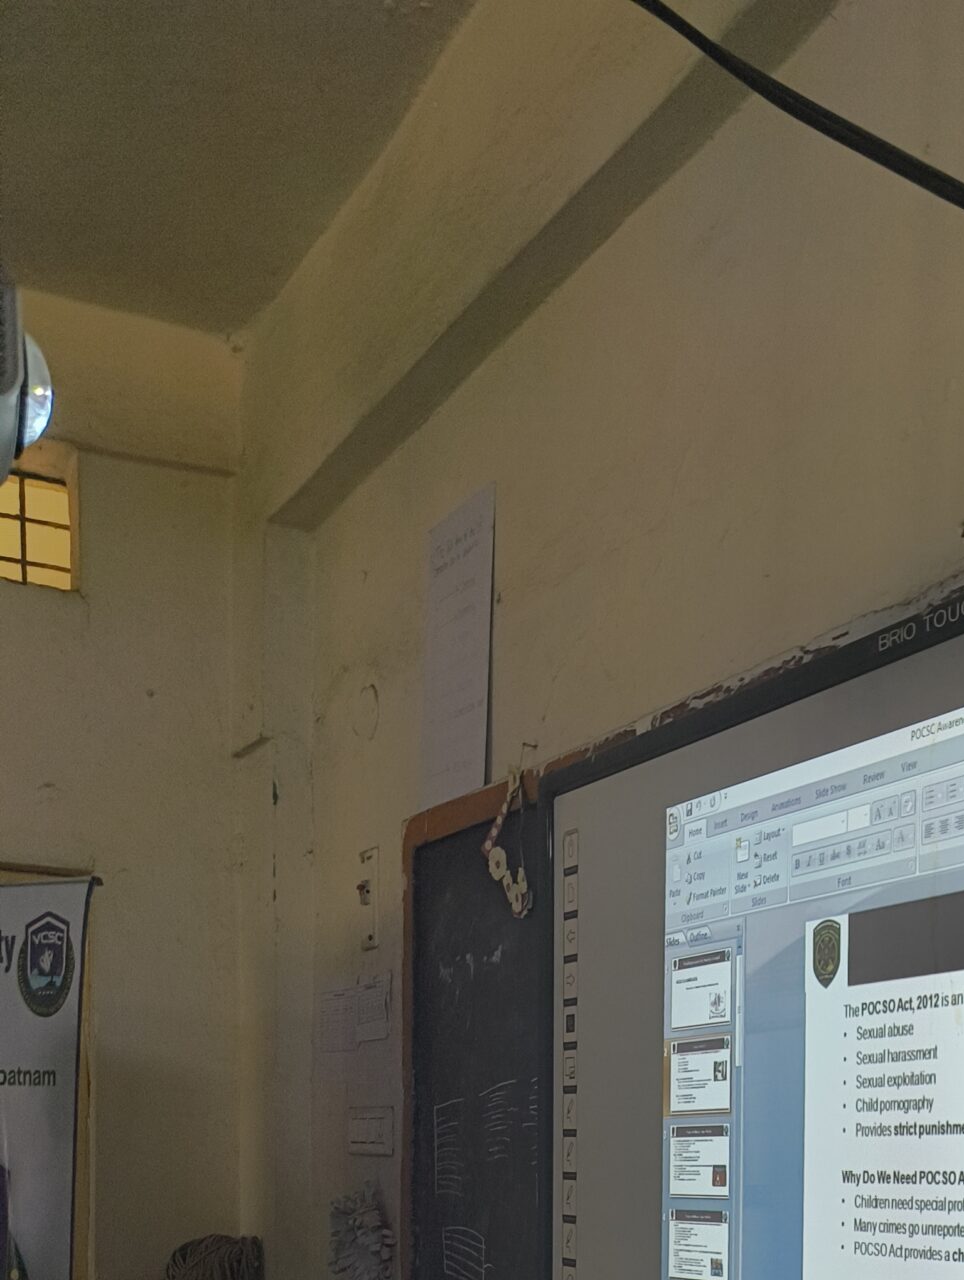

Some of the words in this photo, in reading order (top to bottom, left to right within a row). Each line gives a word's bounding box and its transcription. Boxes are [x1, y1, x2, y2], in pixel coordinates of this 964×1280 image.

[878, 622, 916, 652] BRIO
[815, 788, 829, 799] Slide
[830, 783, 847, 795] Show
[863, 770, 885, 785] Review
[901, 760, 917, 772] View
[763, 829, 781, 842] Layout
[763, 851, 778, 863] Reset
[762, 873, 780, 885] Delete
[837, 875, 852, 889] Font
[32, 931, 64, 945] VCSC
[844, 1003, 860, 1018] The
[861, 998, 896, 1017] POCSO
[897, 996, 915, 1014] Act,
[916, 993, 940, 1011] 2012
[941, 992, 950, 1007] is
[951, 993, 964, 1006] an
[856, 1023, 886, 1041] Sexual
[887, 1022, 914, 1038] abuse
[856, 1048, 886, 1065] Sexual
[887, 1045, 938, 1063] harassment
[856, 1073, 886, 1089] Sexual
[887, 1071, 937, 1090] exploitation
[856, 1097, 878, 1113] Child
[879, 1095, 934, 1115] pornography
[856, 1121, 892, 1138] Provides
[893, 1120, 918, 1136] strict
[842, 1170, 861, 1187] Why
[863, 1170, 875, 1185] Do
[876, 1170, 892, 1185] We
[893, 1170, 917, 1185] Need
[918, 1171, 956, 1186] POCSO
[854, 1194, 890, 1210] Children
[890, 1196, 913, 1210] need
[915, 1196, 947, 1213] special
[853, 1217, 877, 1235] Many
[878, 1219, 907, 1235] crimes
[908, 1223, 920, 1238] go
[853, 1241, 888, 1257] POCSO
[888, 1243, 903, 1258] Act
[903, 1244, 943, 1261] provides
[944, 1251, 950, 1261] a
